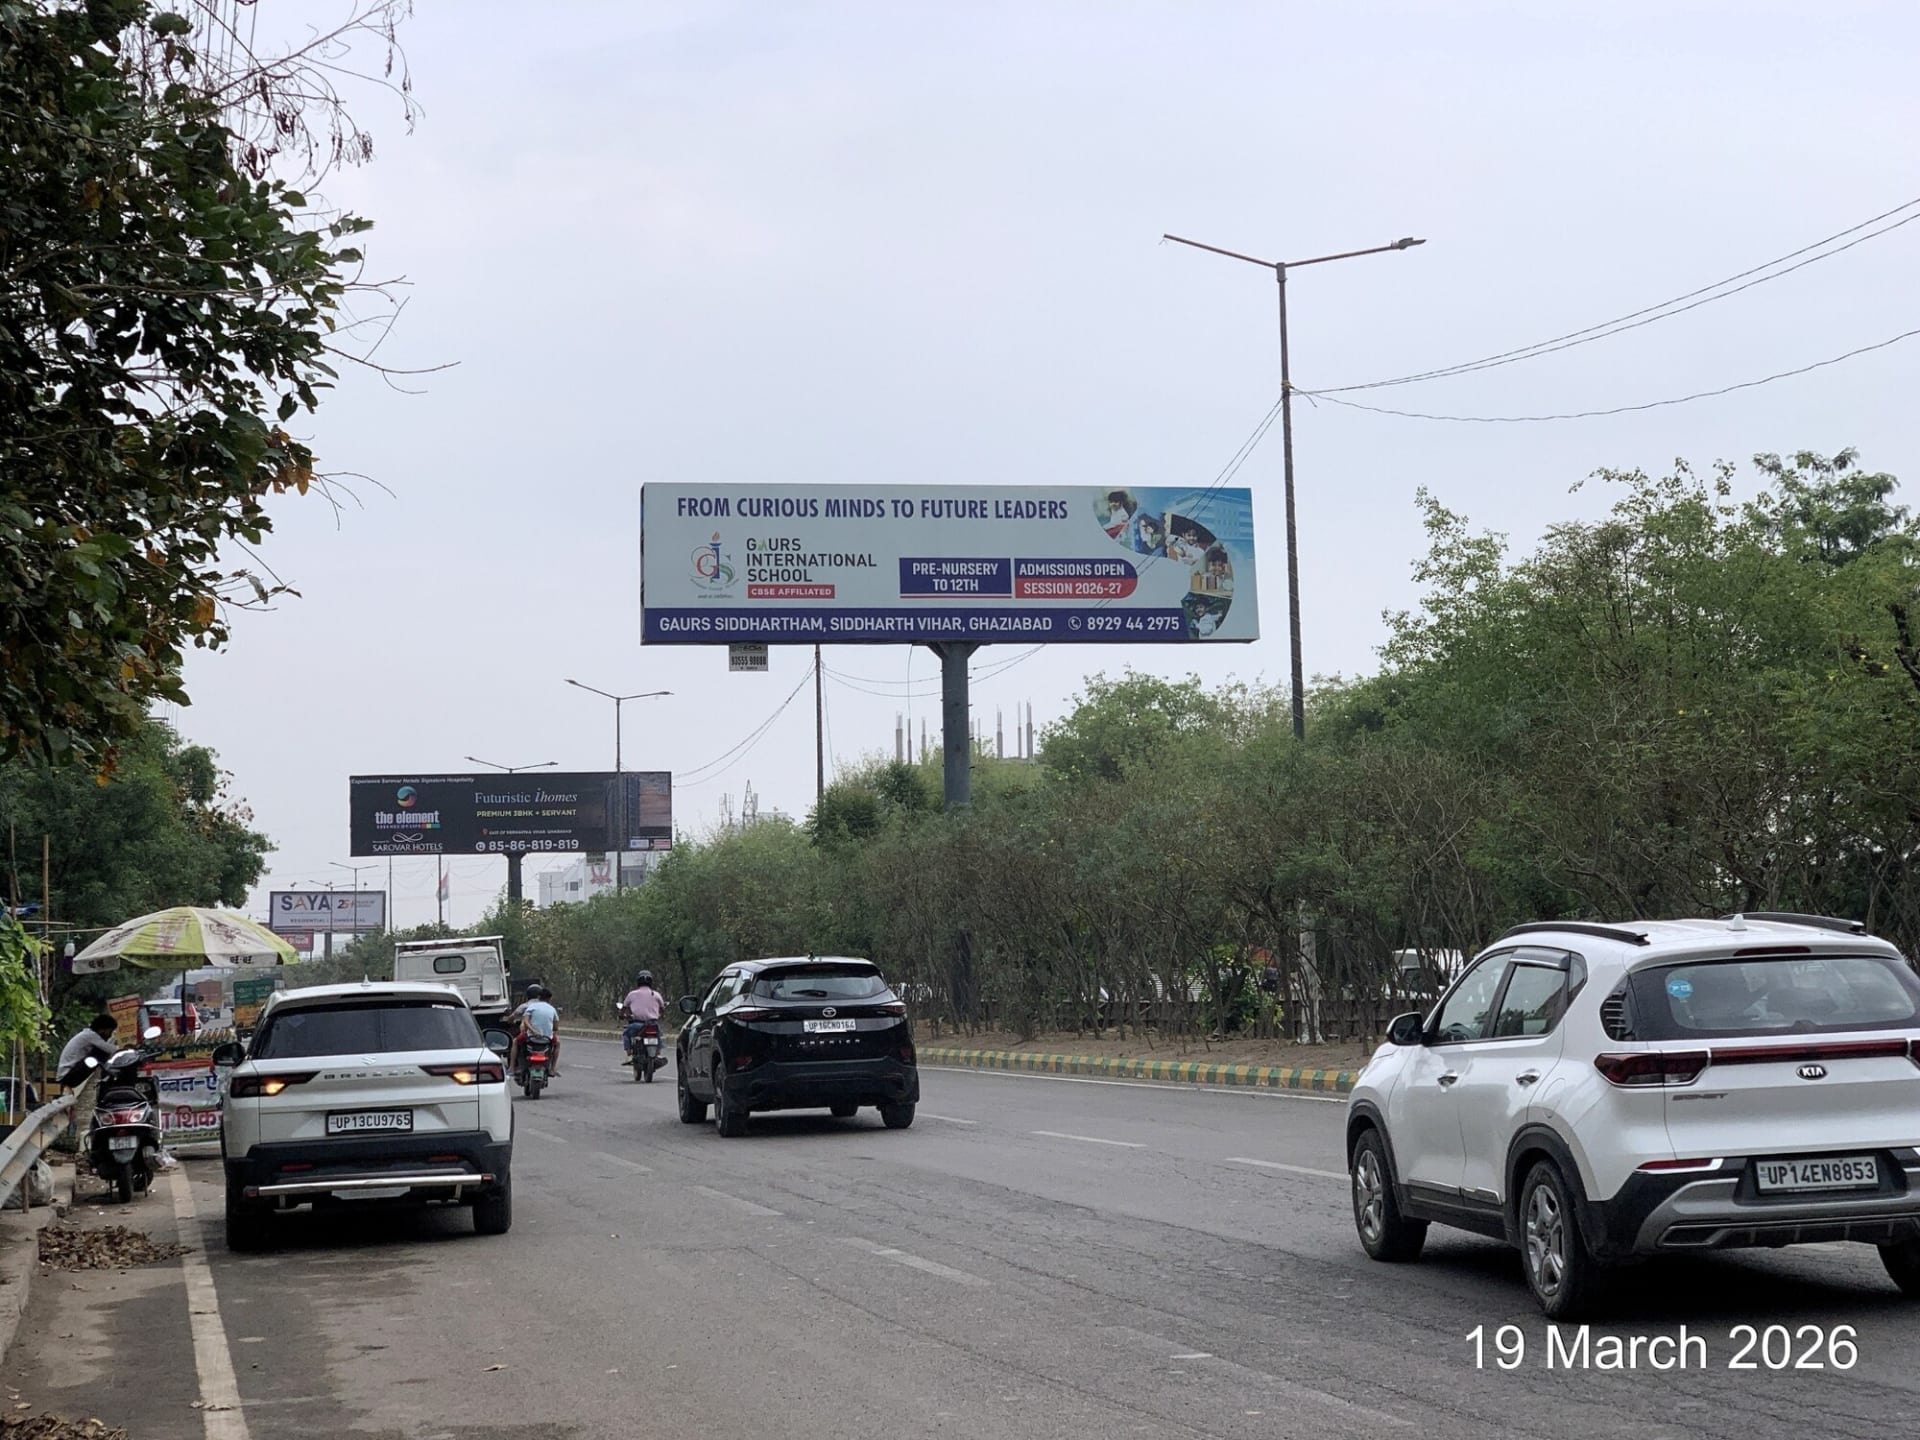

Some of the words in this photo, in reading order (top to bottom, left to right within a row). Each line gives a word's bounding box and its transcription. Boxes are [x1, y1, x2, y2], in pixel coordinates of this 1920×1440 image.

[677, 497, 731, 517] FROM
[736, 497, 819, 518] CURIOUS
[825, 498, 886, 518] MINDS
[891, 499, 914, 518] TO
[921, 499, 988, 519] FUTURE
[995, 499, 1068, 519] LEADERS
[746, 537, 801, 552] GAURS
[746, 552, 877, 567] INTERNATIONAL
[747, 568, 813, 582] SCHOOL
[912, 562, 999, 576] PRE-NURSERY
[1019, 563, 1092, 576] ADMISSIONS
[1094, 563, 1126, 576] OPEN
[751, 587, 776, 596] CBSE
[778, 587, 832, 596] AFFILIATED
[933, 578, 948, 592] TO
[950, 578, 979, 592] 12TH
[1023, 582, 1073, 595] SESSION
[1075, 582, 1123, 595] 2026-27
[659, 617, 711, 631] GAURS
[714, 617, 827, 633] SIDDHARTHAM,
[830, 617, 914, 631] SIDDHARTH
[917, 617, 966, 632] VIHAR,
[969, 617, 1053, 631] GHAZIABAD
[1087, 616, 1122, 631] 8929
[1126, 616, 1144, 631] 44
[1147, 616, 1180, 631] 2975
[475, 791, 531, 804] Futuristic
[375, 811, 394, 825] the
[395, 810, 440, 824] element
[476, 809, 512, 818] PREMIUM
[541, 809, 577, 817] SERVANT
[372, 843, 412, 853] SAROVAR
[413, 842, 443, 851] HOTELS
[488, 839, 579, 851] 85-86-819-819
[280, 894, 331, 911] SAYA
[1801, 1066, 1824, 1078] KIA
[335, 1113, 411, 1129] UP13CU9765
[1767, 1161, 1876, 1185] UP14EN8853
